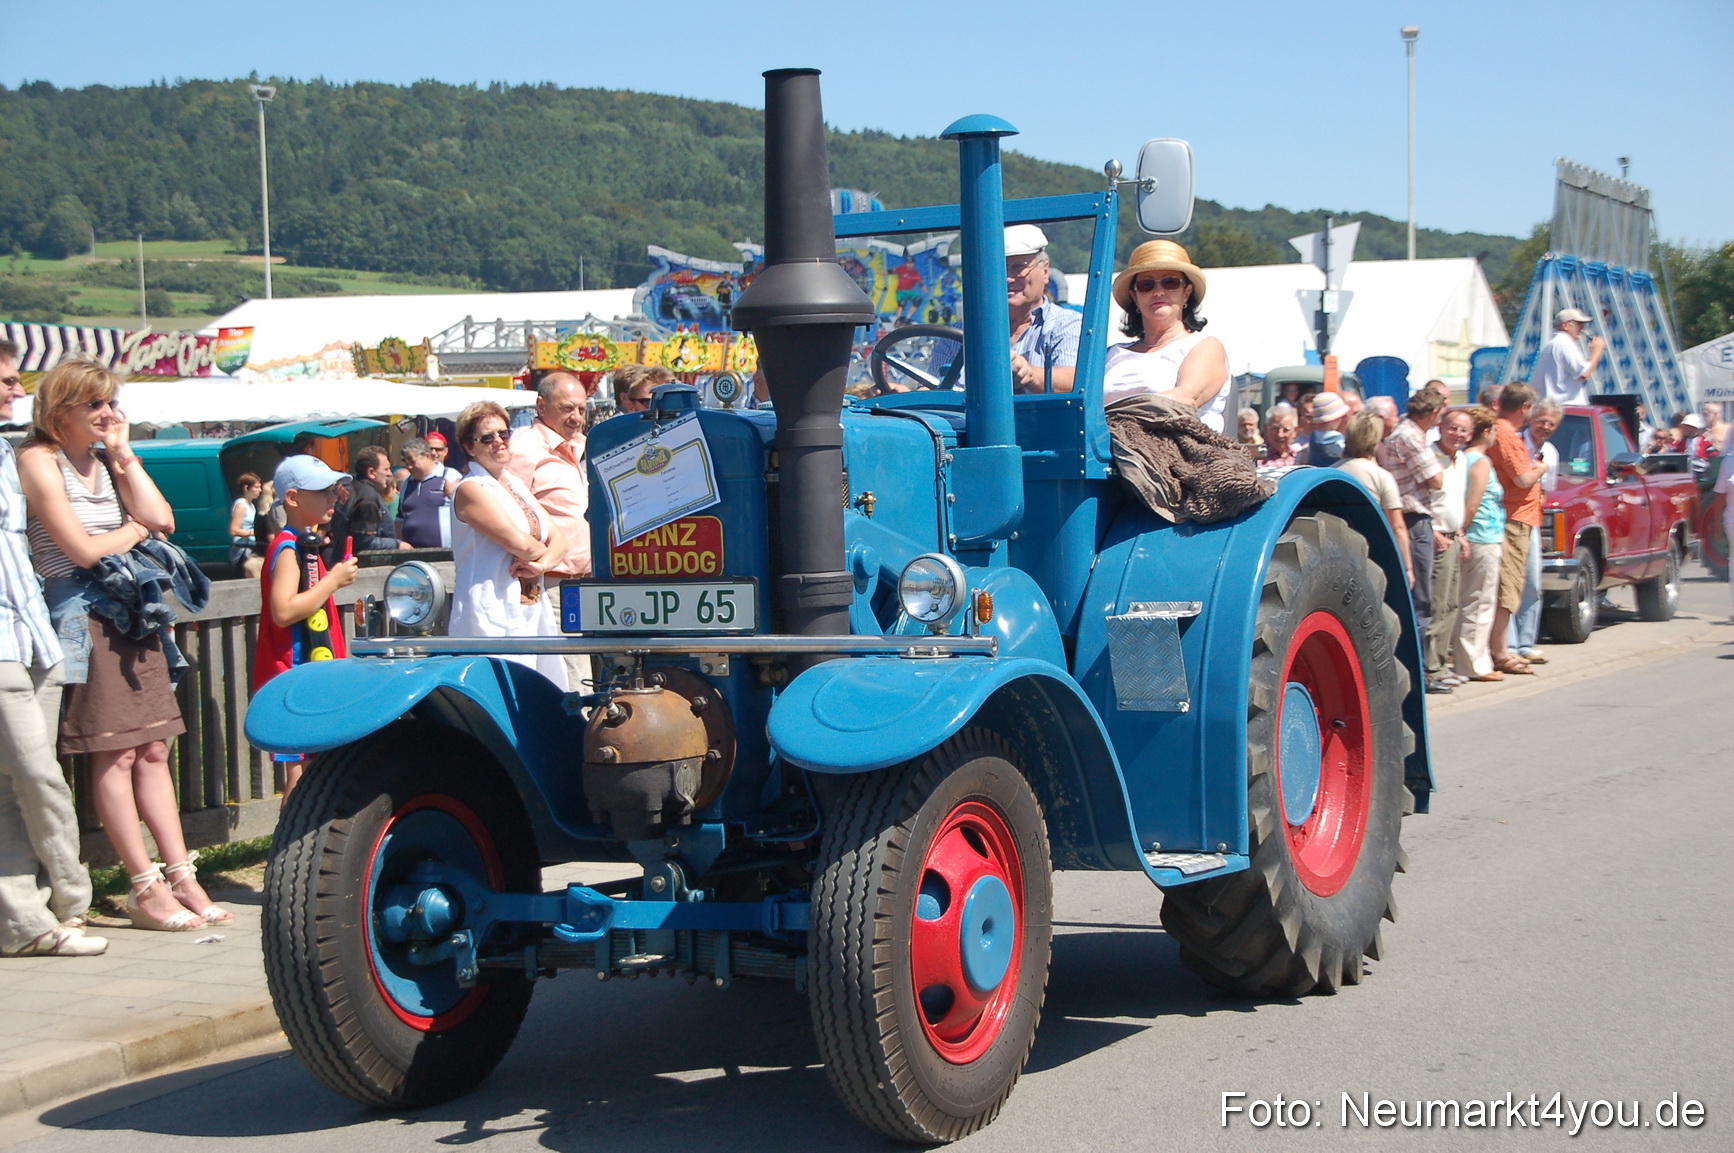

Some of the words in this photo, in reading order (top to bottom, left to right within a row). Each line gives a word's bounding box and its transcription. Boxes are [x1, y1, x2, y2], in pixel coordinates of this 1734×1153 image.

[632, 523, 697, 547] LANZ
[613, 551, 717, 576] BULLDOG
[569, 612, 576, 623] D
[597, 591, 618, 625] R
[640, 591, 681, 625] JP
[696, 590, 737, 624] 65
